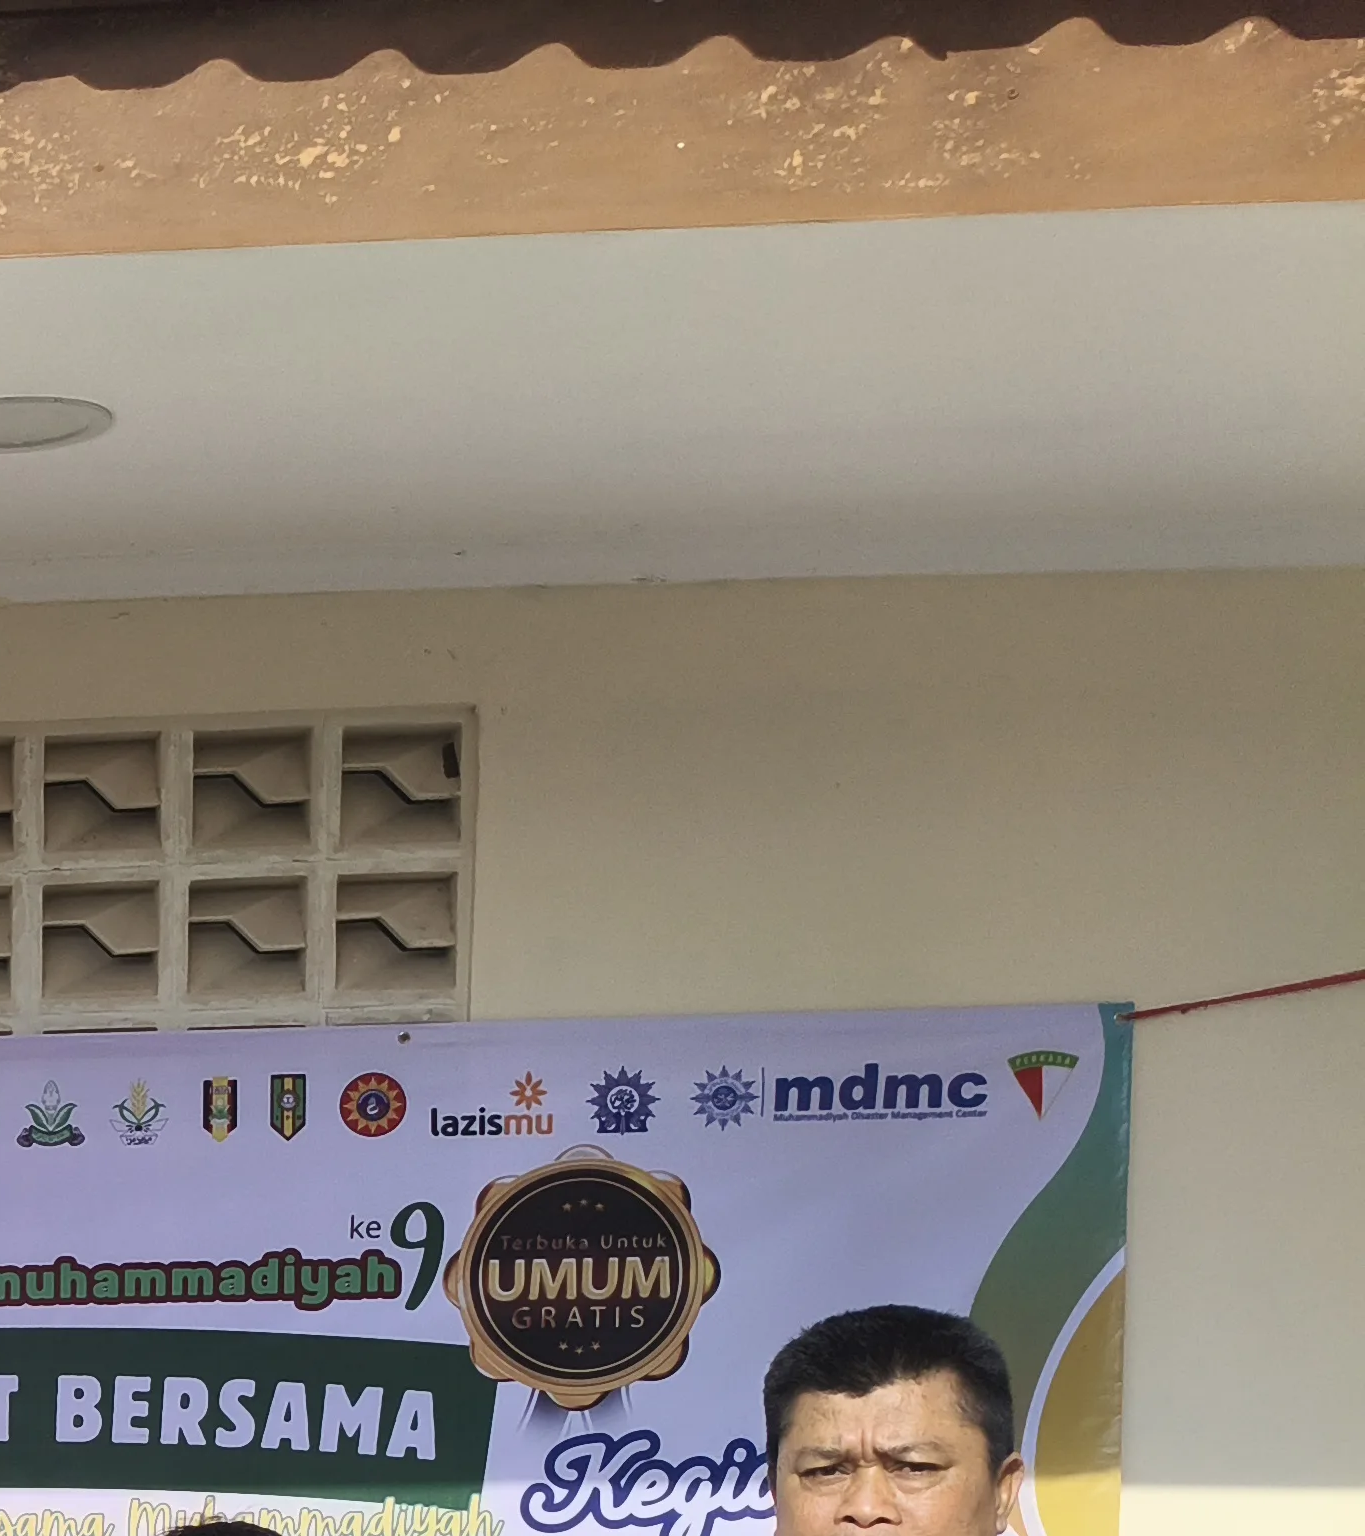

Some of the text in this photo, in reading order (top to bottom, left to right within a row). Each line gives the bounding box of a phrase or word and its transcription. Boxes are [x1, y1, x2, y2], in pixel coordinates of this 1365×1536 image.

[773, 1063, 988, 1112] mdmc
[430, 1106, 553, 1137] lazismu
[349, 1201, 445, 1311] ke 9
[500, 1233, 668, 1251] Terbuka Untuk
[488, 1256, 671, 1302] UMUM
[511, 1305, 645, 1329] GRATIS
[55, 1374, 437, 1461] BERSAMA
